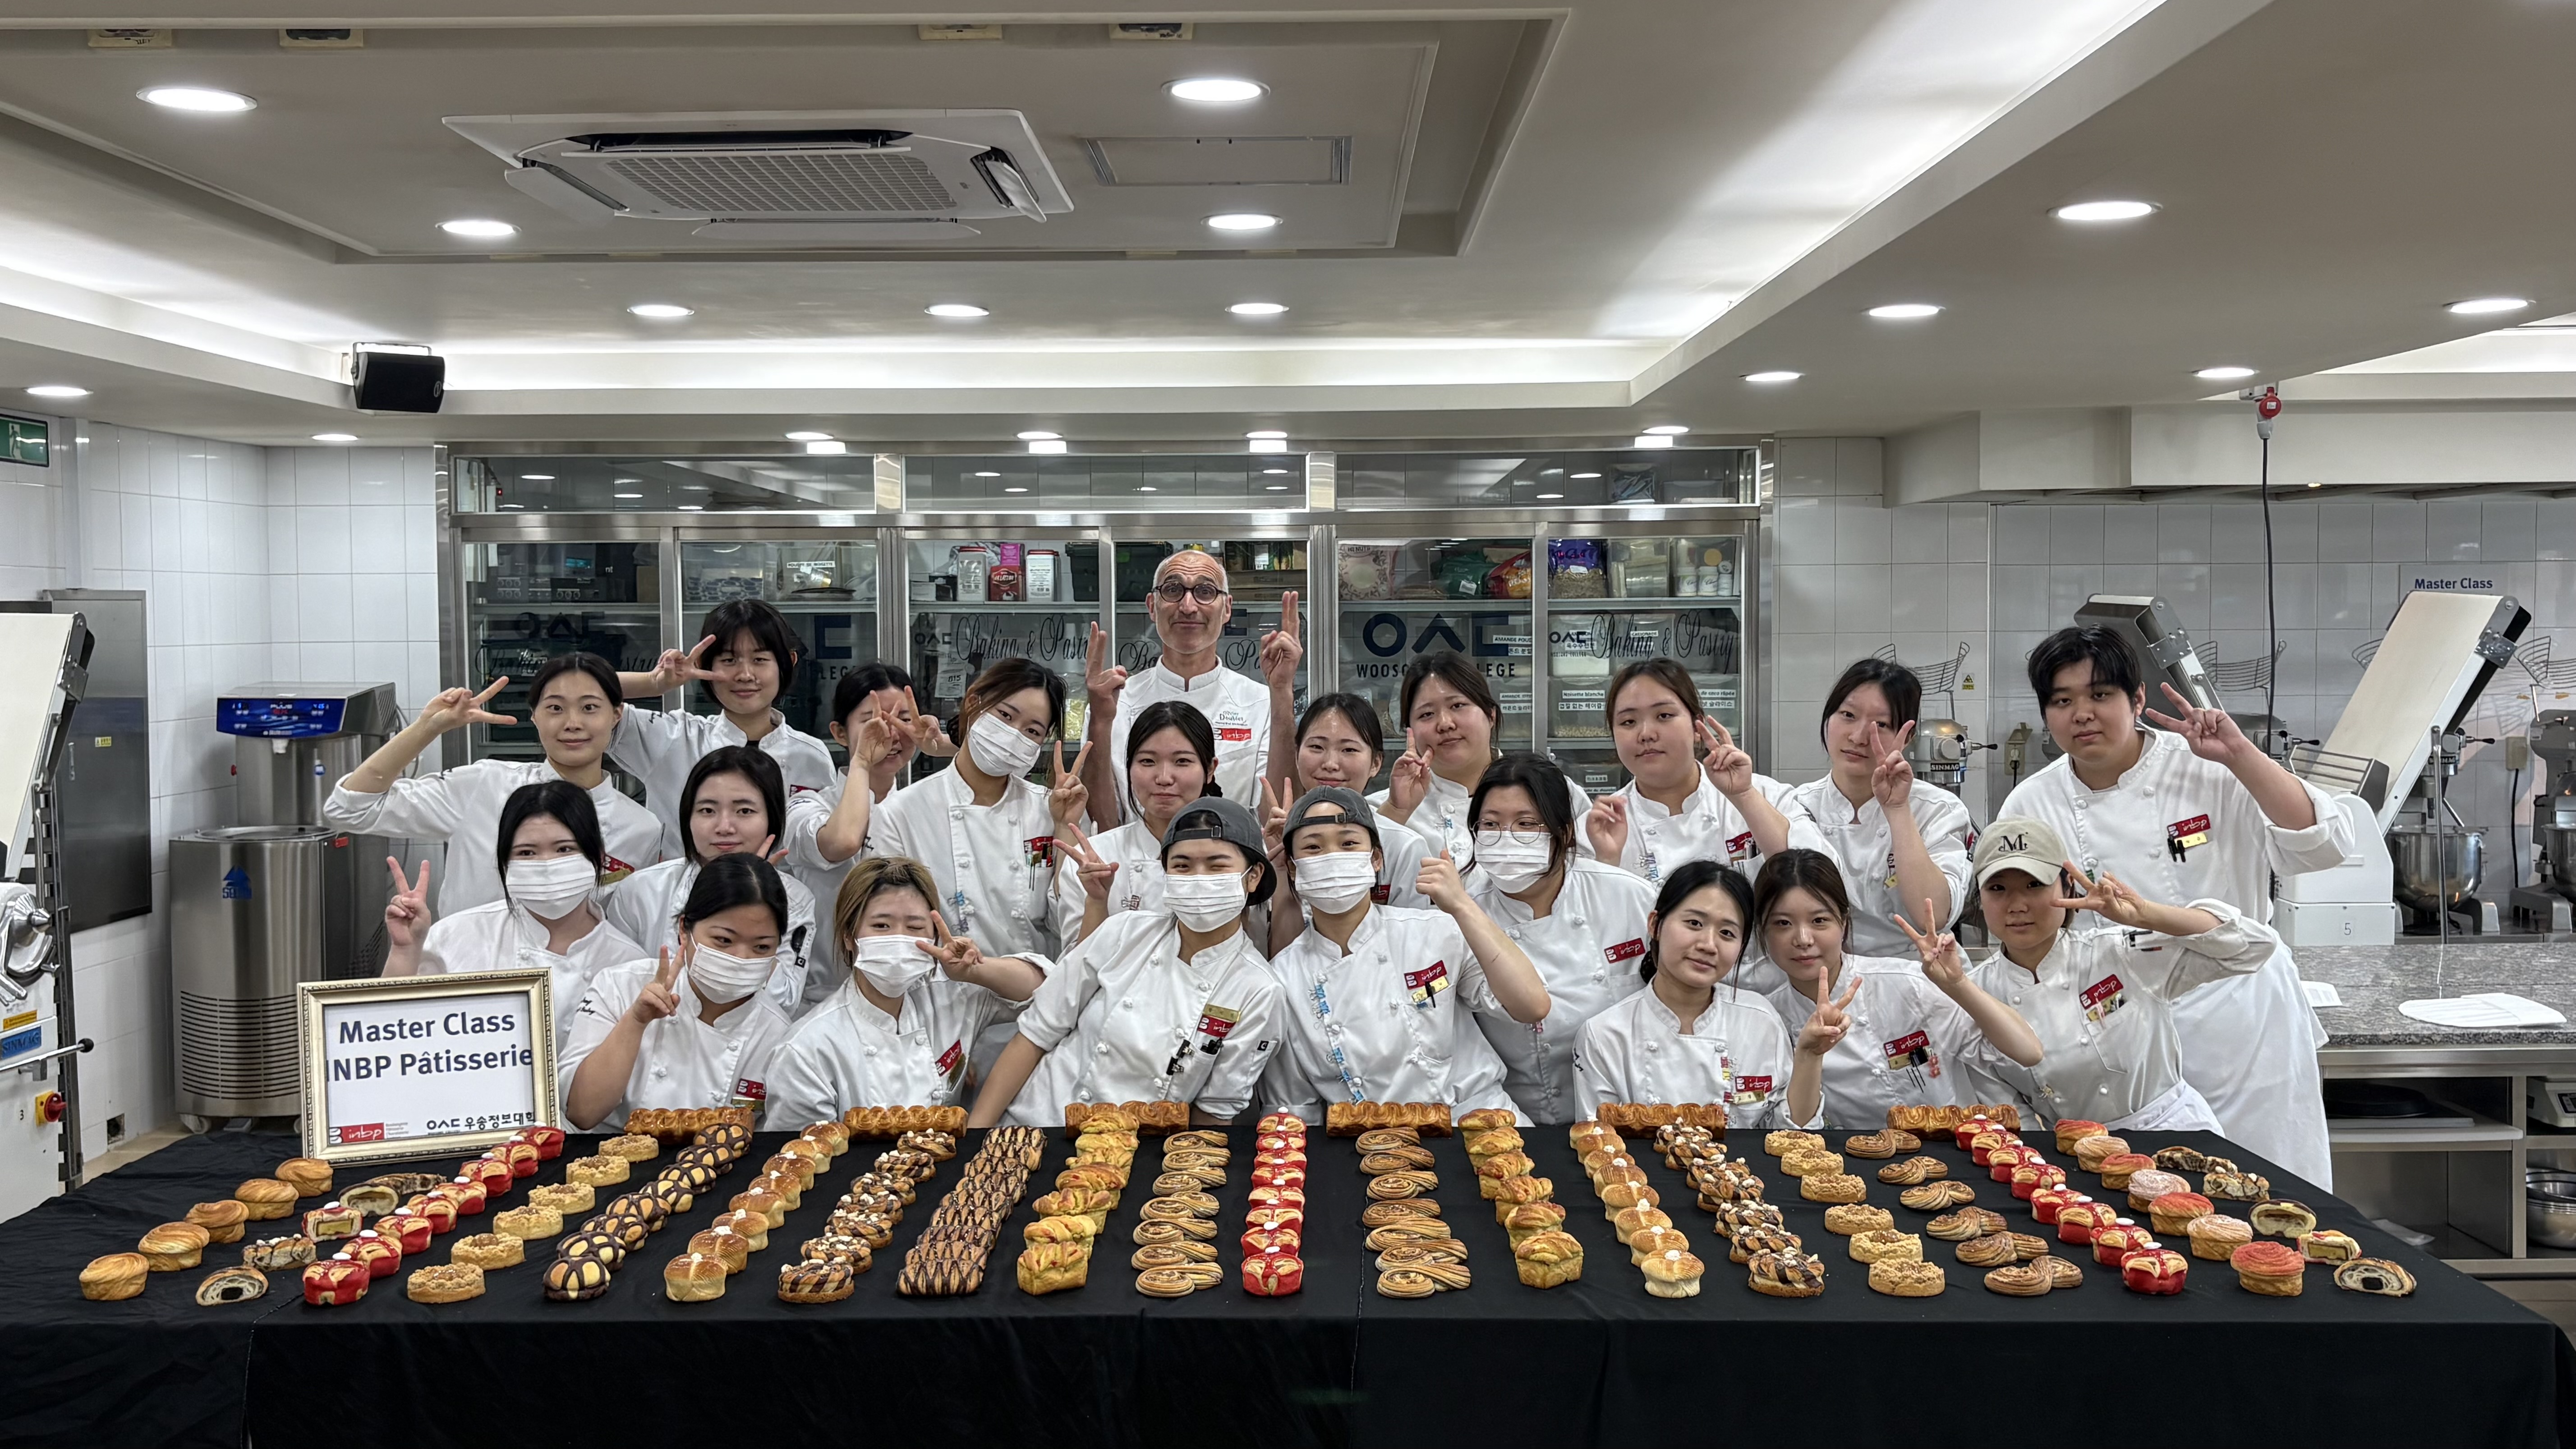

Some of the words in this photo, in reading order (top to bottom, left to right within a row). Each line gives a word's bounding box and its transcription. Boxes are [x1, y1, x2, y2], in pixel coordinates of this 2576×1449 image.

[2414, 578, 2458, 589] Master
[2460, 578, 2493, 589] Class
[1027, 630, 1035, 659] &
[1040, 612, 1089, 662] Pastr
[1661, 627, 1670, 656] &
[1675, 609, 1735, 675] Pastry
[1357, 663, 1410, 678] WOOS
[2344, 922, 2351, 936] 5
[339, 1018, 436, 1044] Master
[443, 1012, 516, 1035] Class
[1213, 1021, 1229, 1033] inb
[400, 1044, 532, 1076] Pâtisserie
[19, 1109, 24, 1121] 3
[349, 1125, 382, 1141] inbp
